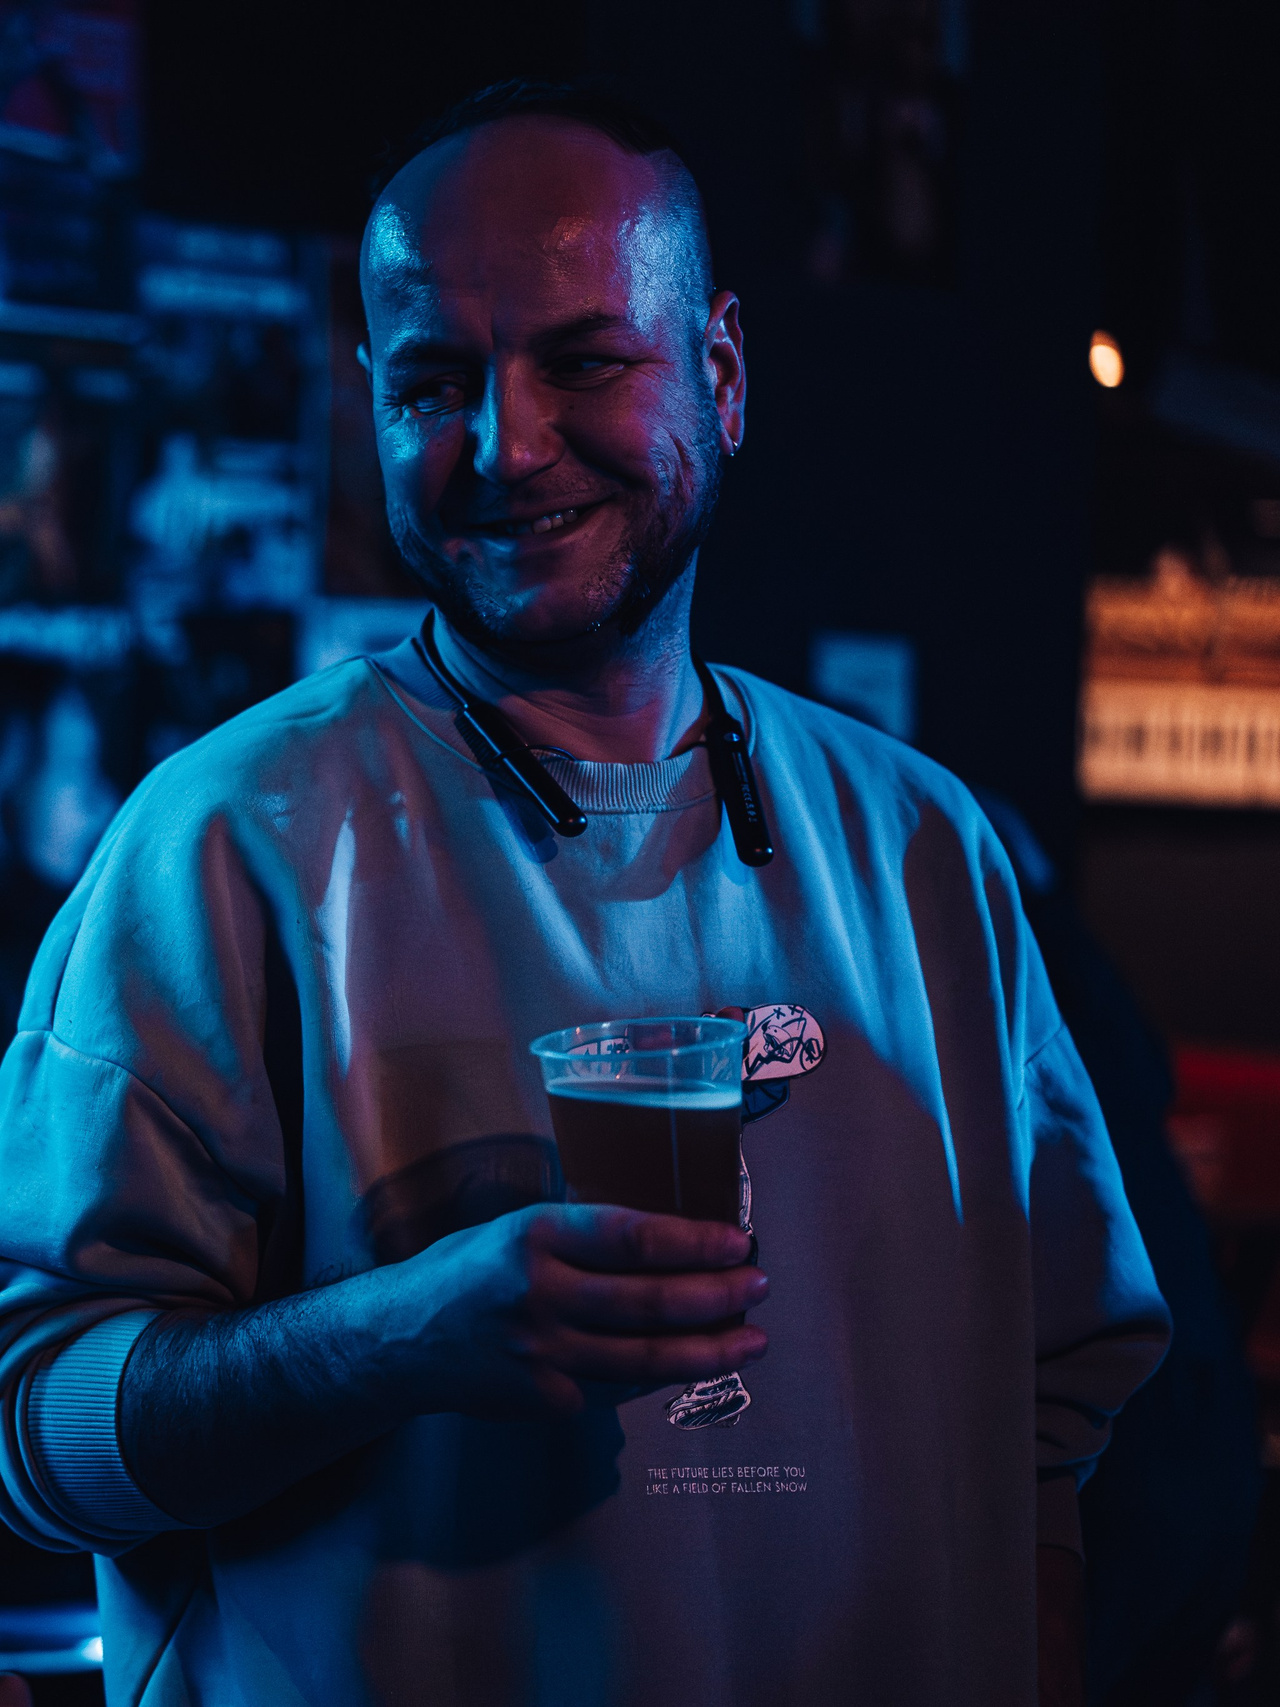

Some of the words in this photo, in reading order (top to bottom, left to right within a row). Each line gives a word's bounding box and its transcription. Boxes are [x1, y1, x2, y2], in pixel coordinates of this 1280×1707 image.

[647, 1468, 668, 1479] THE
[671, 1467, 709, 1479] FUTURE
[712, 1466, 734, 1479] LIES
[737, 1466, 780, 1478] BEFORE
[783, 1466, 806, 1478] YOU
[646, 1483, 669, 1495] LIKE
[672, 1484, 680, 1494] A
[683, 1482, 709, 1494] FIELD
[711, 1482, 727, 1493] OF
[731, 1482, 771, 1493] FALLEN
[775, 1481, 808, 1493] SNOW
